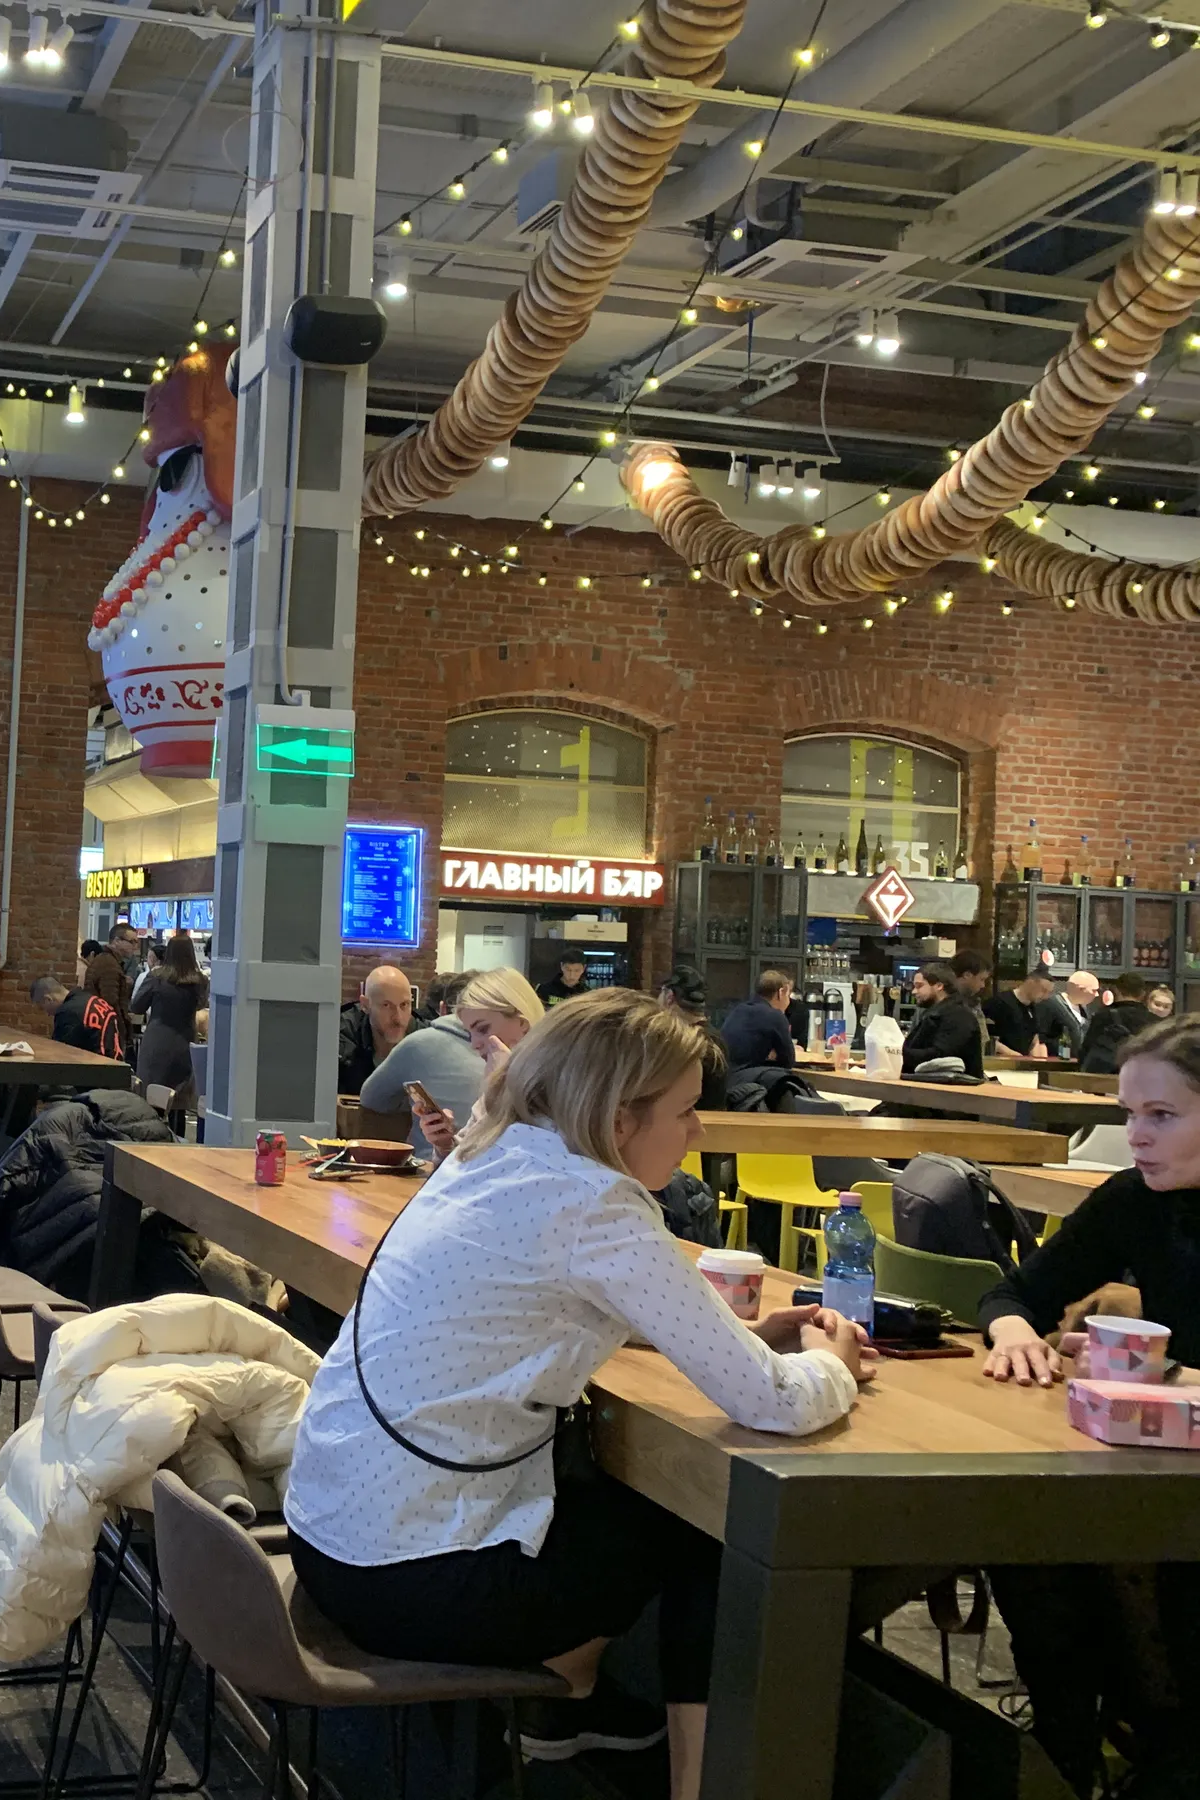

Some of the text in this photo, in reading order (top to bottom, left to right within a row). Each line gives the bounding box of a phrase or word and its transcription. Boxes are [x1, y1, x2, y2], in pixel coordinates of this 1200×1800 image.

[443, 859, 665, 899] ГЛАВНЫЙ БАР
[891, 841, 930, 879] 35
[86, 869, 124, 898] BISTRO
